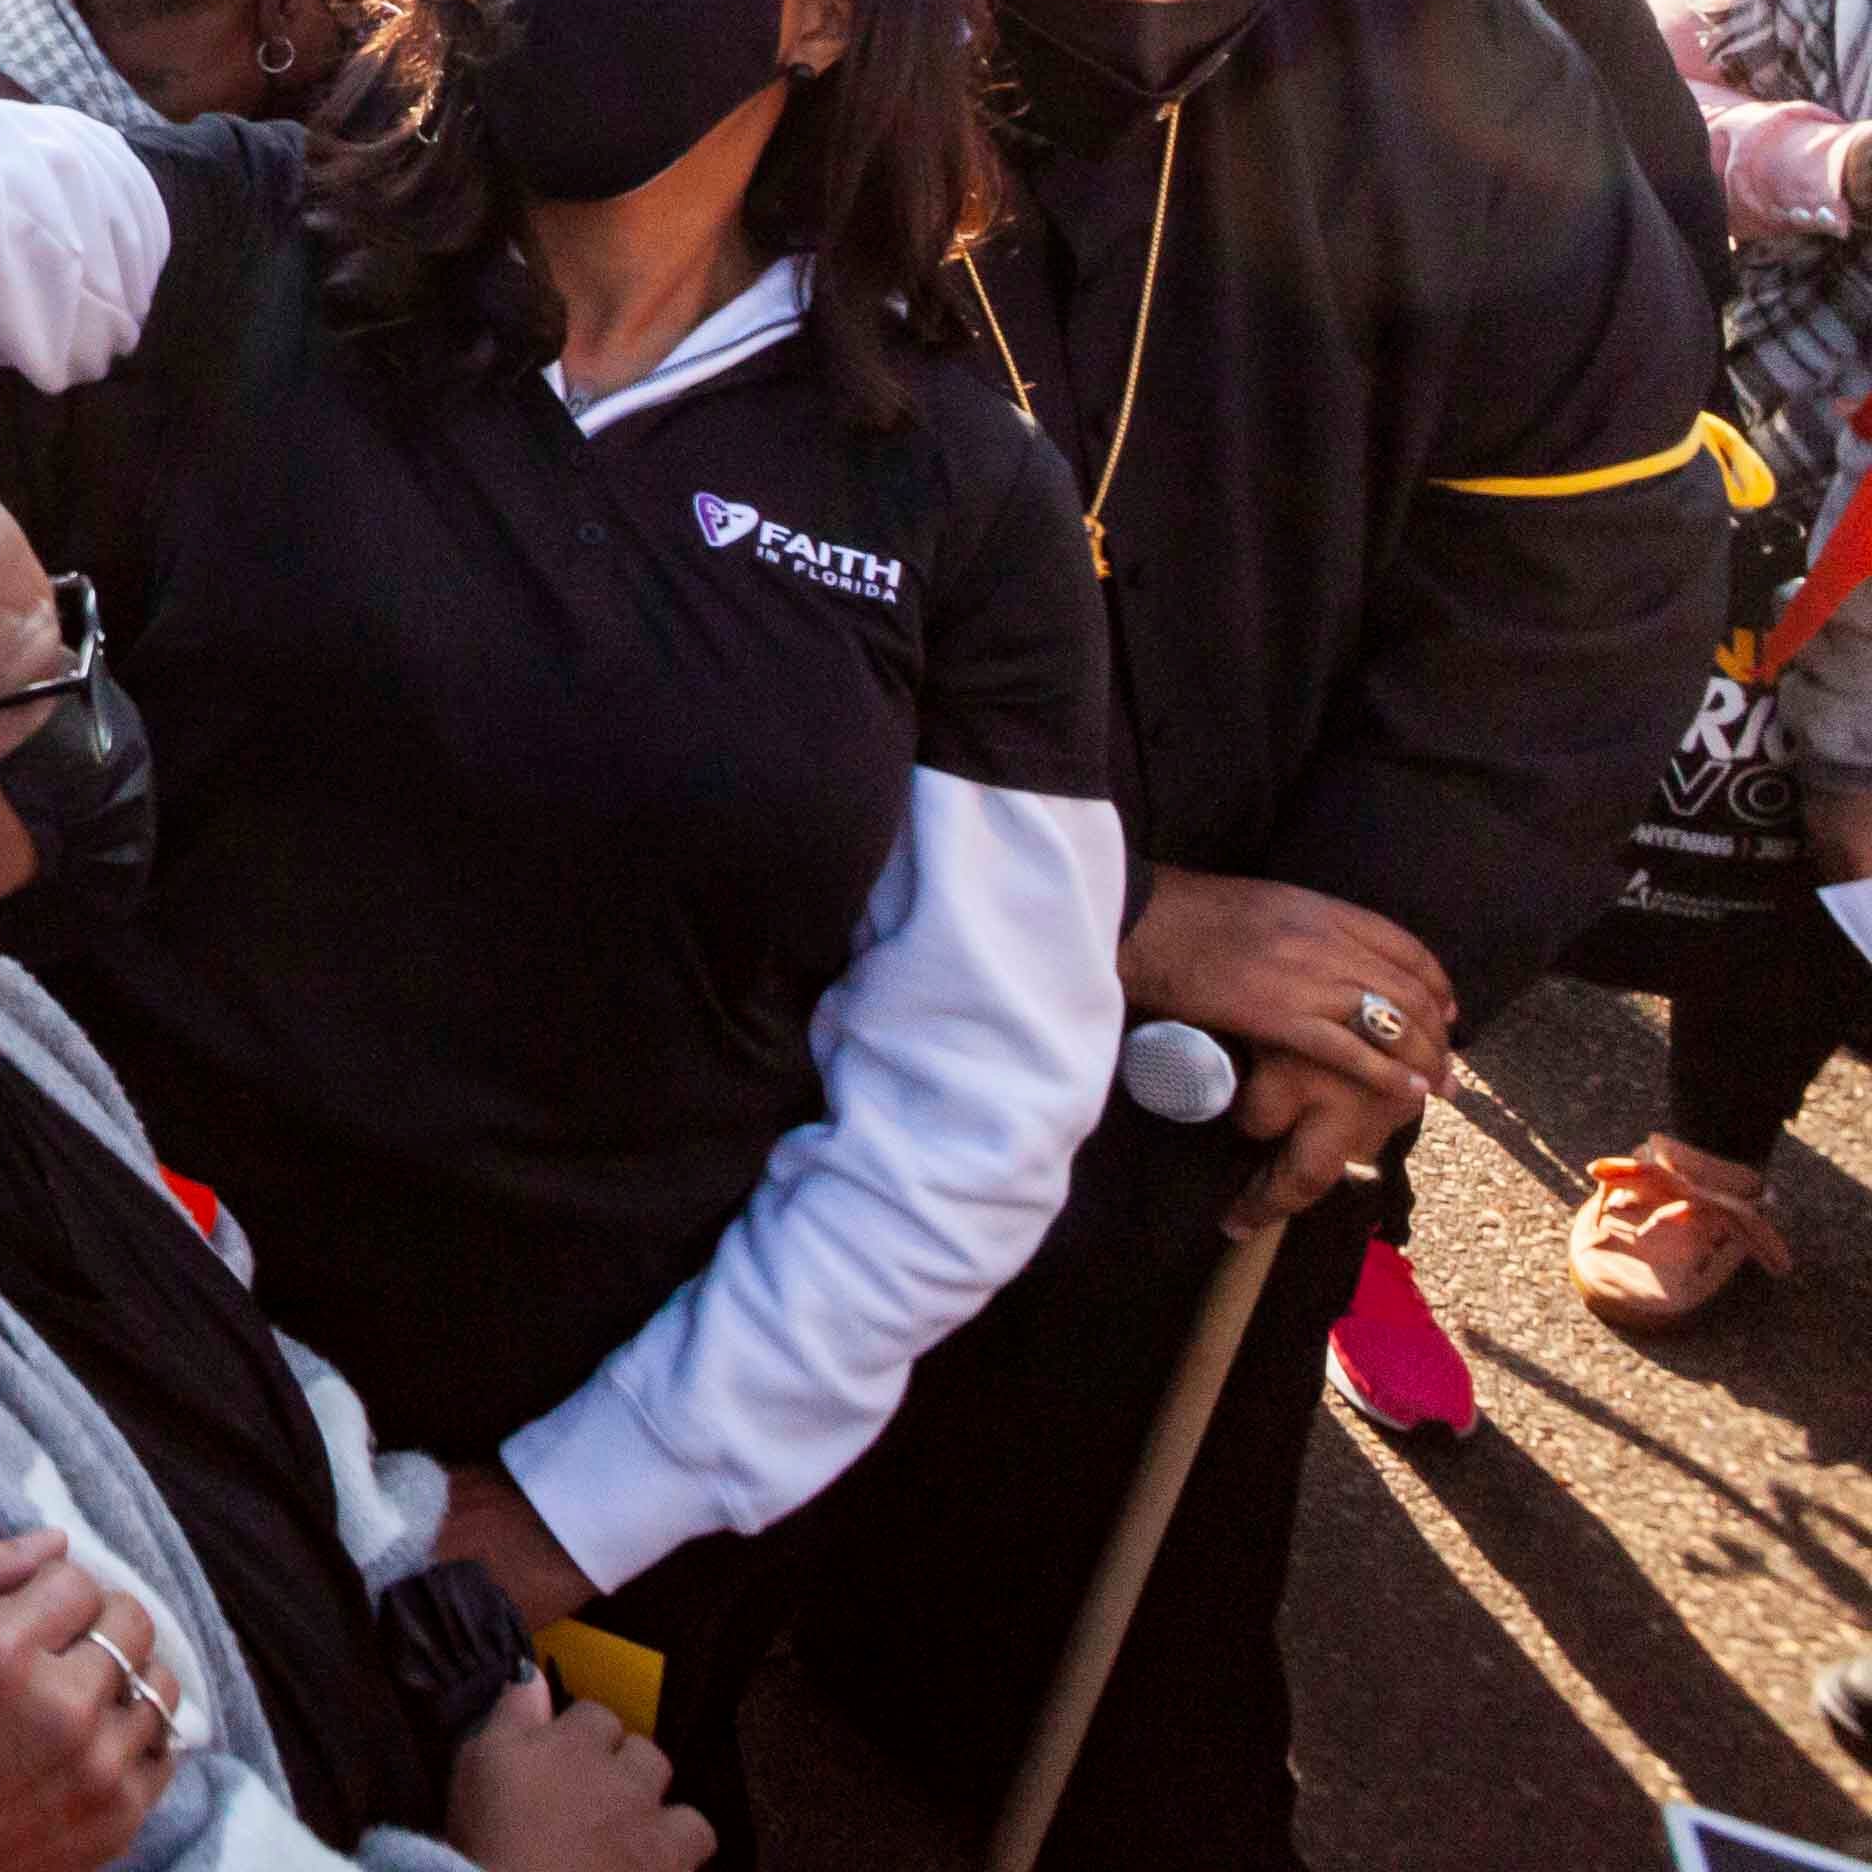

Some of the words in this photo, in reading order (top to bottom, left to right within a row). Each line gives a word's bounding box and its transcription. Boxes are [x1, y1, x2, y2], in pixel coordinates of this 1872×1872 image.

[757, 546, 780, 564] IN
[794, 559, 897, 604] FLORIDA
[759, 520, 901, 588] FAITH
